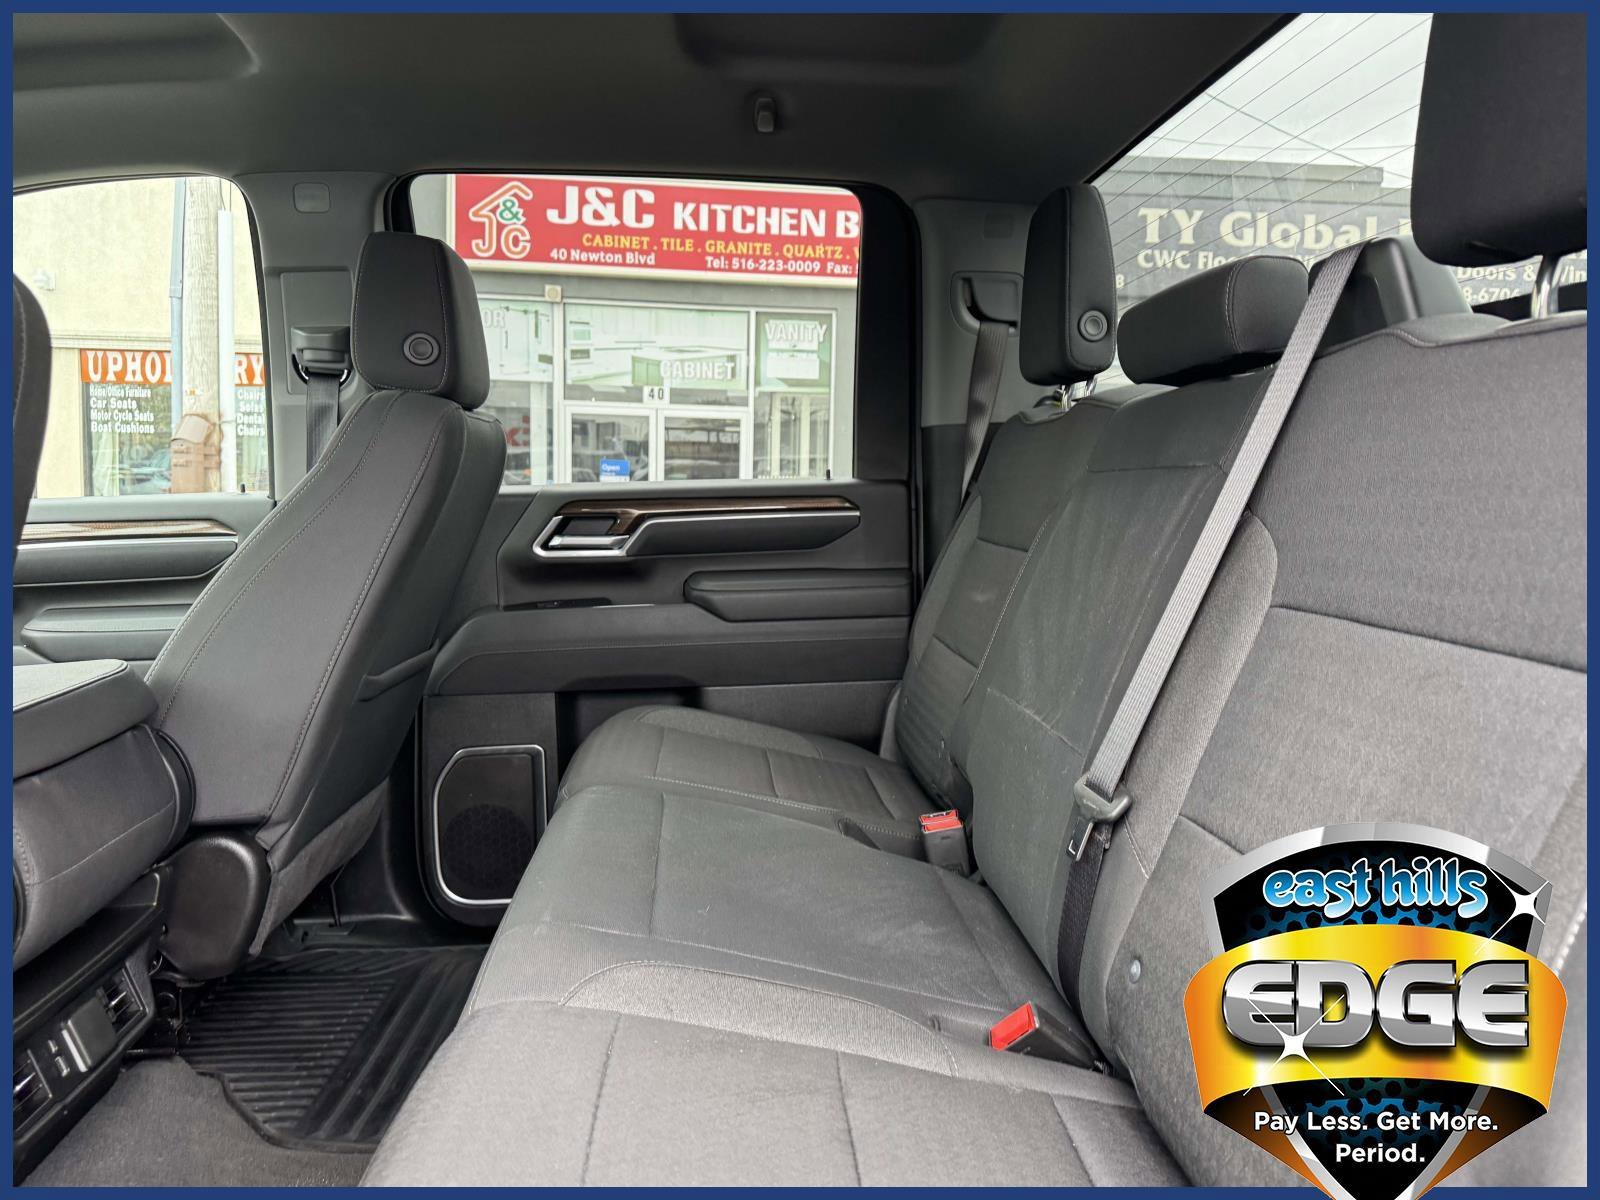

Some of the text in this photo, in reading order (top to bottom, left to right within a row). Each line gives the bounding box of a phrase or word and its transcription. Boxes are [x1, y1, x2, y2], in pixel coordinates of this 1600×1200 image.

[546, 185, 655, 228] J&C
[673, 202, 826, 237] KITCHEN
[1137, 207, 1204, 245] TY
[1219, 210, 1377, 250] Global
[582, 233, 650, 249] CABINET
[661, 237, 694, 252] TILE
[705, 240, 772, 257] GRANITE
[783, 244, 843, 260] QUARTZ
[550, 248, 656, 266] 40 Newton Blvd
[705, 256, 729, 270] Tel:
[732, 257, 820, 273] 516-223-0009
[826, 262, 853, 275] Fax:
[1137, 249, 1191, 270] CWC
[1523, 265, 1536, 282] &
[765, 321, 827, 343] VANITY
[660, 360, 735, 380] CABINET
[90, 397, 107, 409] Car
[648, 387, 665, 400] 40
[90, 408, 112, 421] Motor
[91, 421, 155, 434] Boat Cushions
